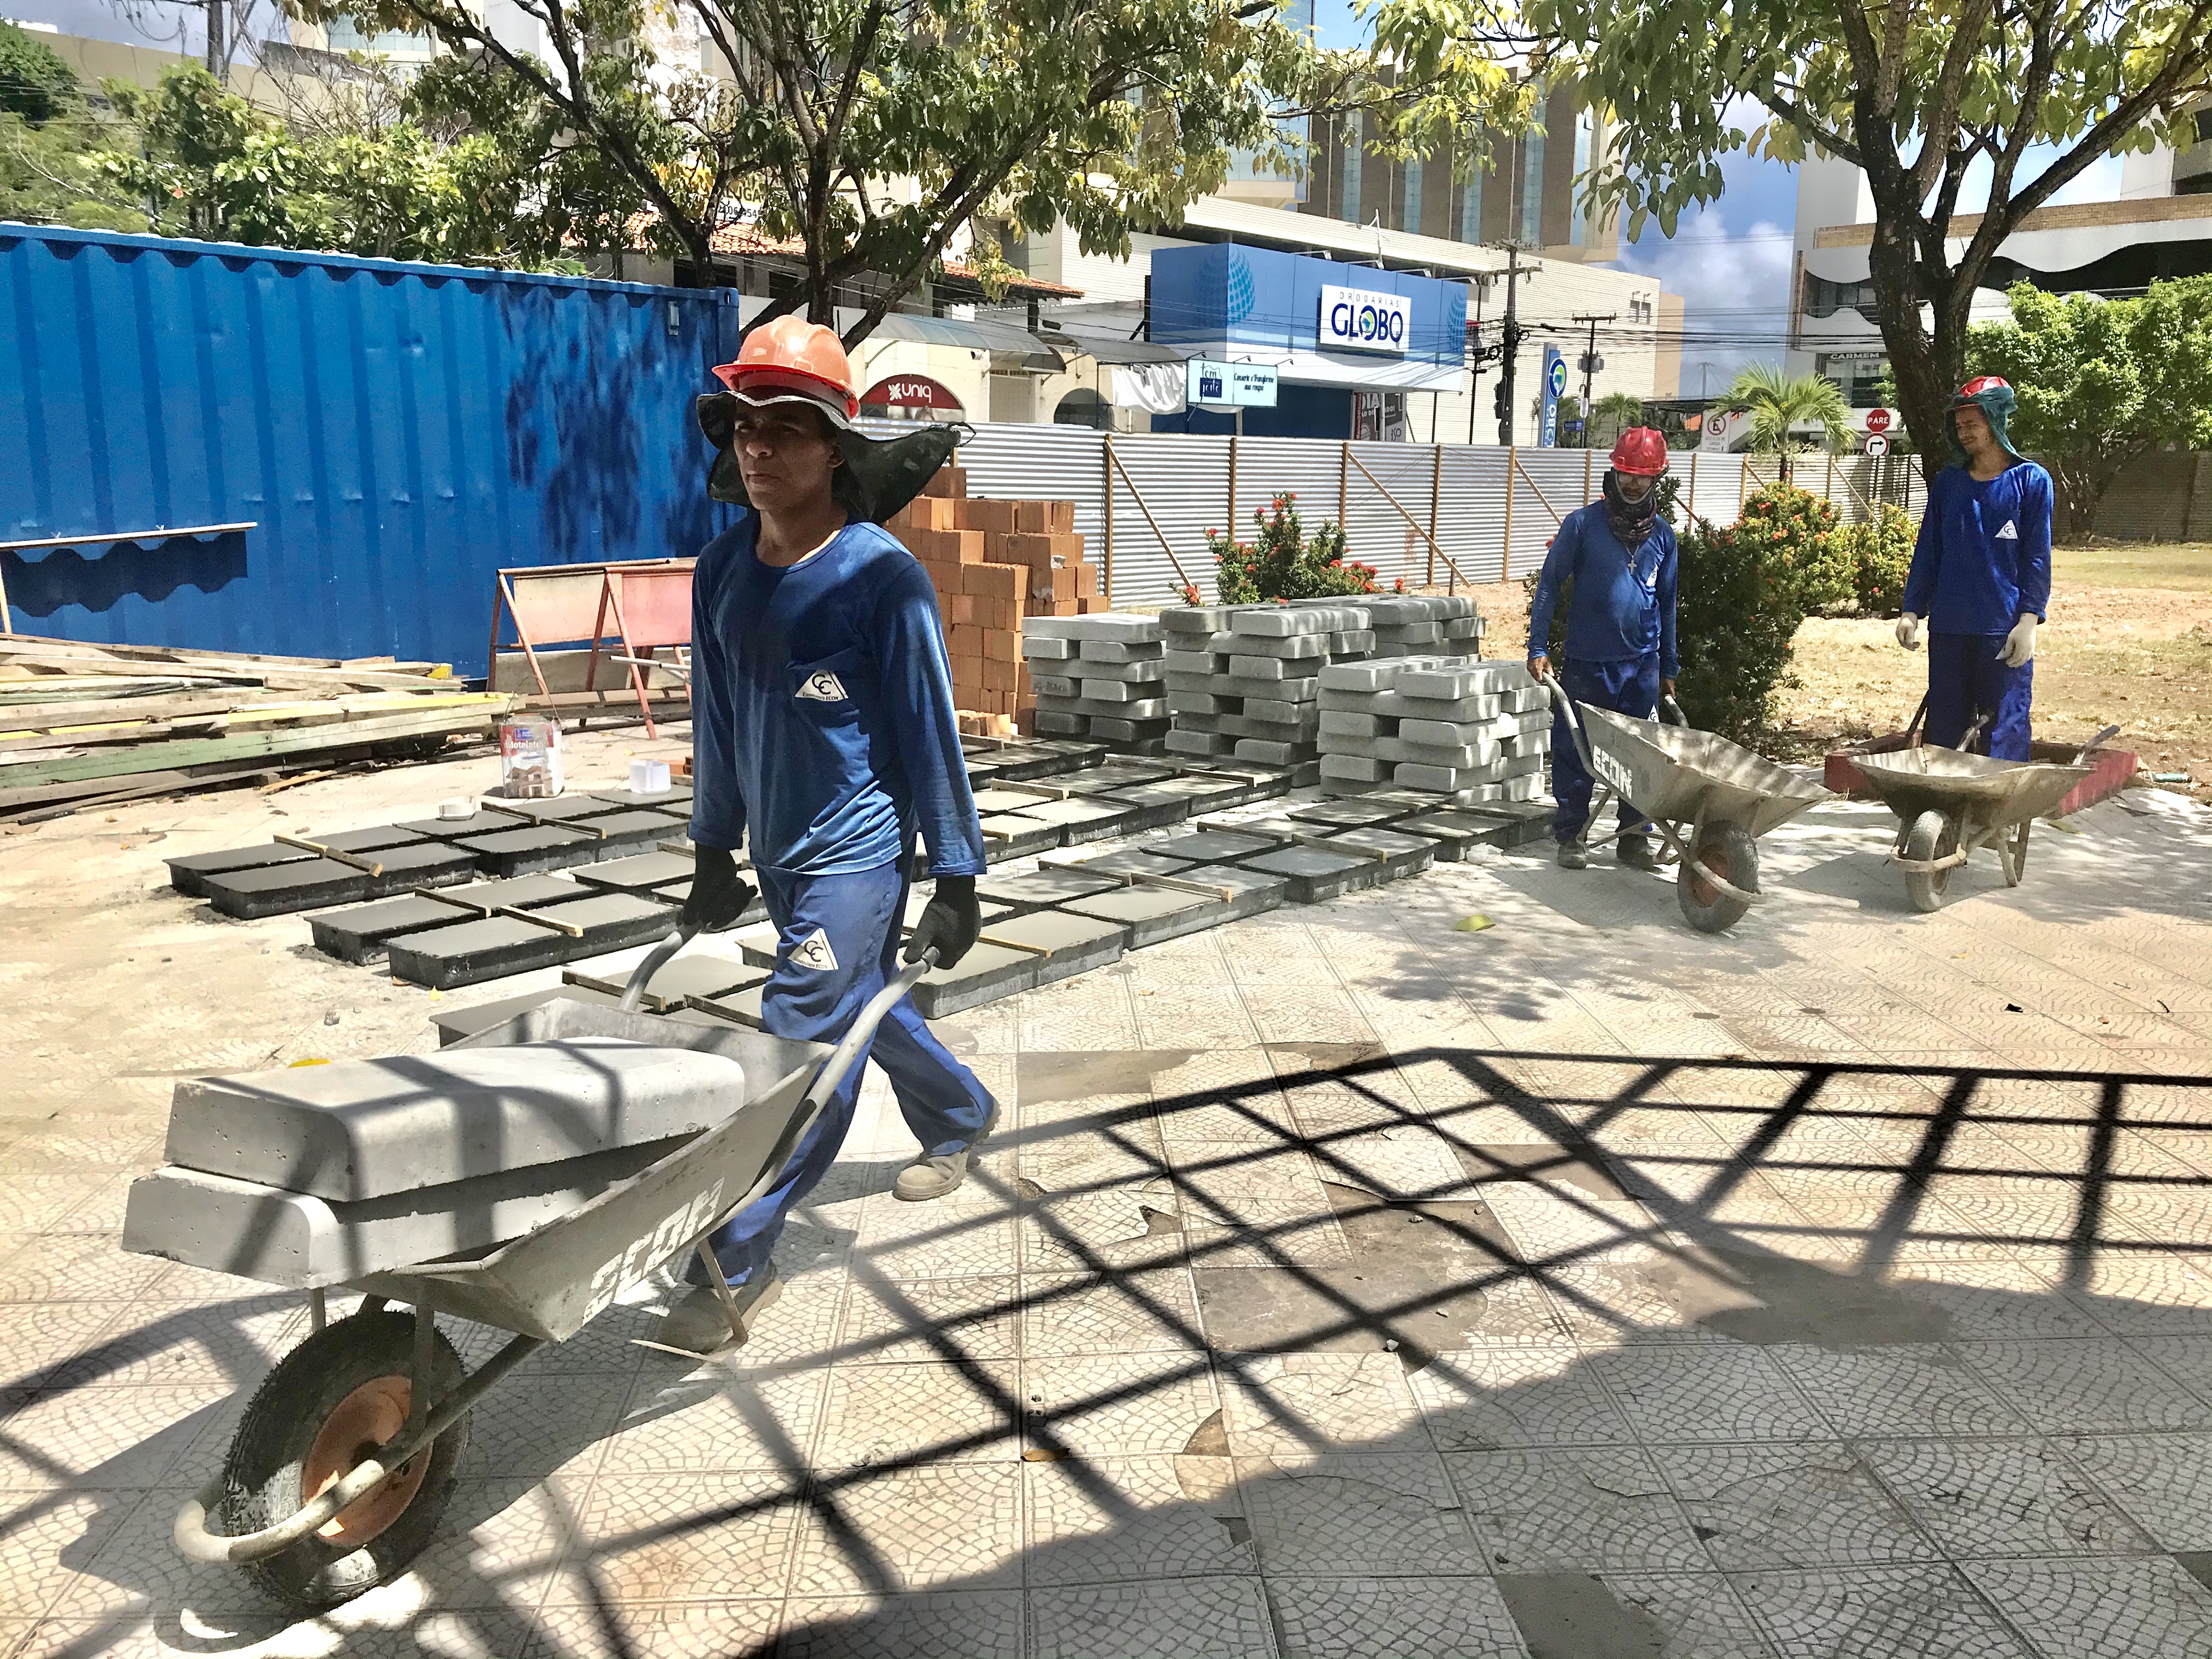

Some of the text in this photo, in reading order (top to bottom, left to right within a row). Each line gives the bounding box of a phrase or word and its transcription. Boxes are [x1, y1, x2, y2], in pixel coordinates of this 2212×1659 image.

[1340, 291, 1400, 308] DROGARIAS
[1331, 303, 1403, 342] GLOBO
[1546, 404, 1556, 448] LOBO
[1593, 745, 1632, 799] ECON
[582, 1176, 725, 1327] ECON
